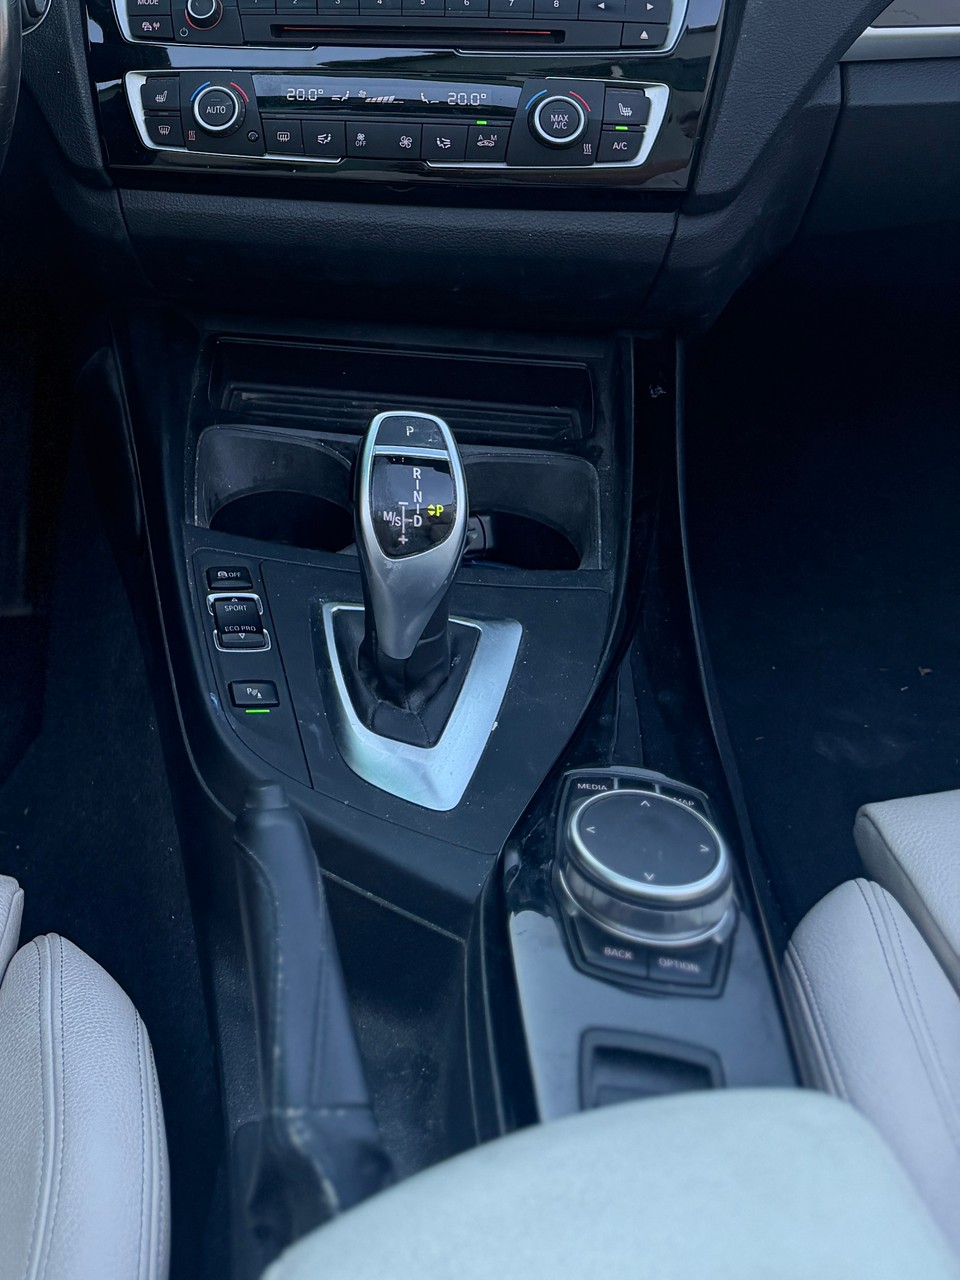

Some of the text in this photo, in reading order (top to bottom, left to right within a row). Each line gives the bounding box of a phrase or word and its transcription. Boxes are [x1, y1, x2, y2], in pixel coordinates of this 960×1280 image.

[509, 0, 515, 7] 7
[553, 0, 559, 8] 8
[206, 106, 226, 114] AUTO
[551, 114, 569, 122] MAX
[553, 122, 568, 130] A/C
[613, 141, 628, 151] A/C
[406, 426, 414, 437] P
[413, 467, 422, 479] R
[413, 491, 422, 503] N
[436, 504, 445, 517] P
[383, 511, 402, 527] M/S
[413, 515, 423, 527] D
[577, 783, 608, 792] MEDIA
[604, 947, 633, 960] BACK
[659, 958, 699, 973] OPTION
